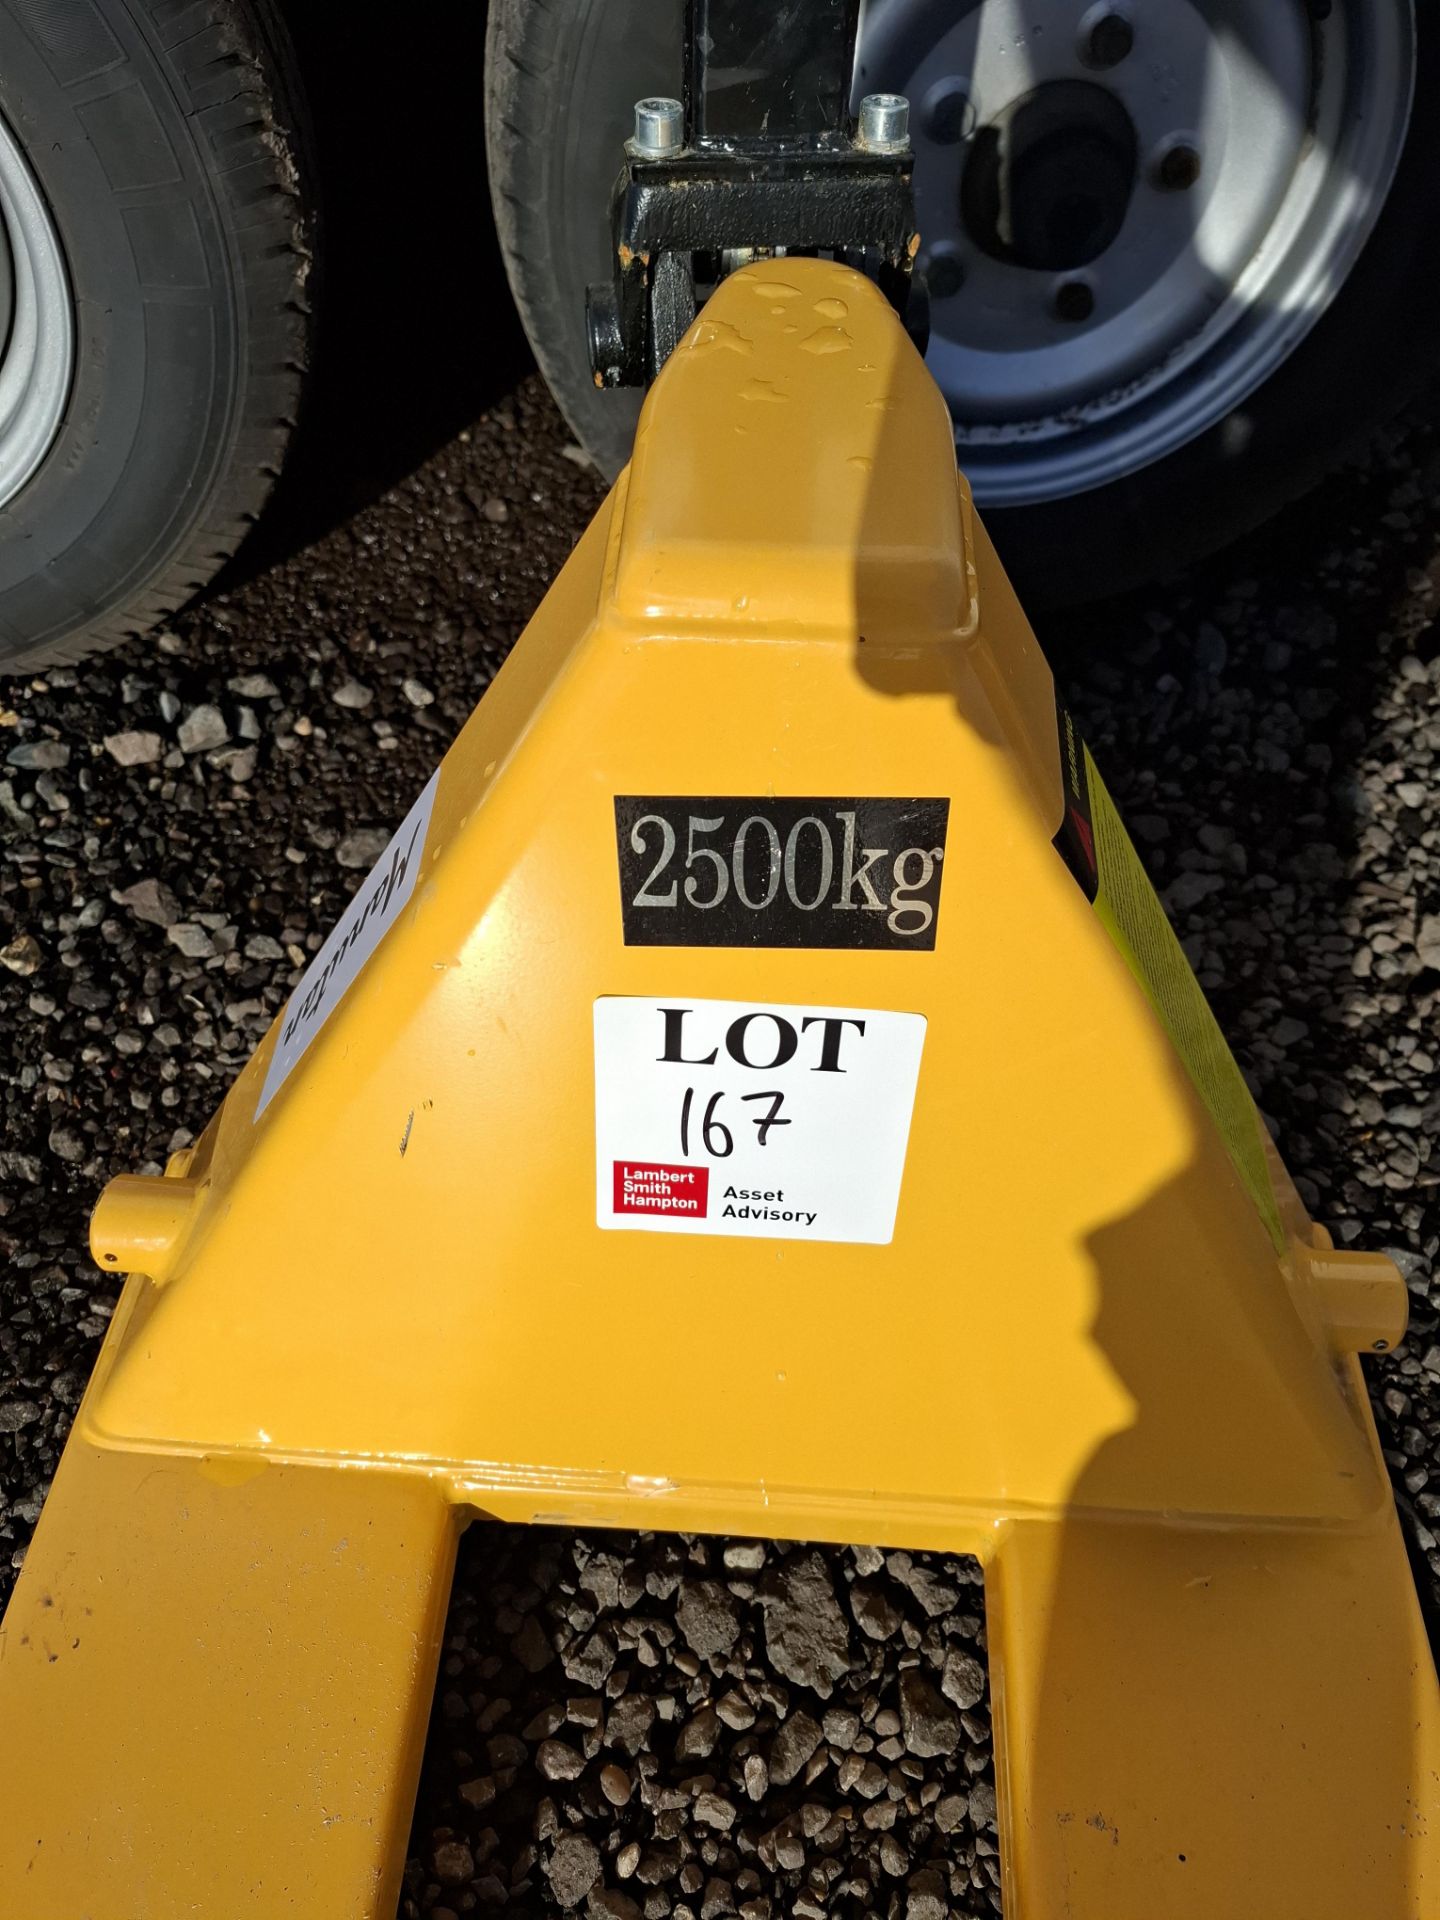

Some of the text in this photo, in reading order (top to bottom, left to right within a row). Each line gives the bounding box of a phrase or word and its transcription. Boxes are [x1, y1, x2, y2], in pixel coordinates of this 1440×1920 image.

[631, 812, 943, 935] 2500kg
[284, 819, 422, 1046] Manutan
[656, 1008, 865, 1073] LOT
[681, 1087, 792, 1158] 167
[623, 1167, 695, 1183] Lambert
[623, 1181, 671, 1195] Smith
[723, 1185, 785, 1202] Asset
[623, 1193, 698, 1210] Hampton
[722, 1204, 817, 1226] Advisory
